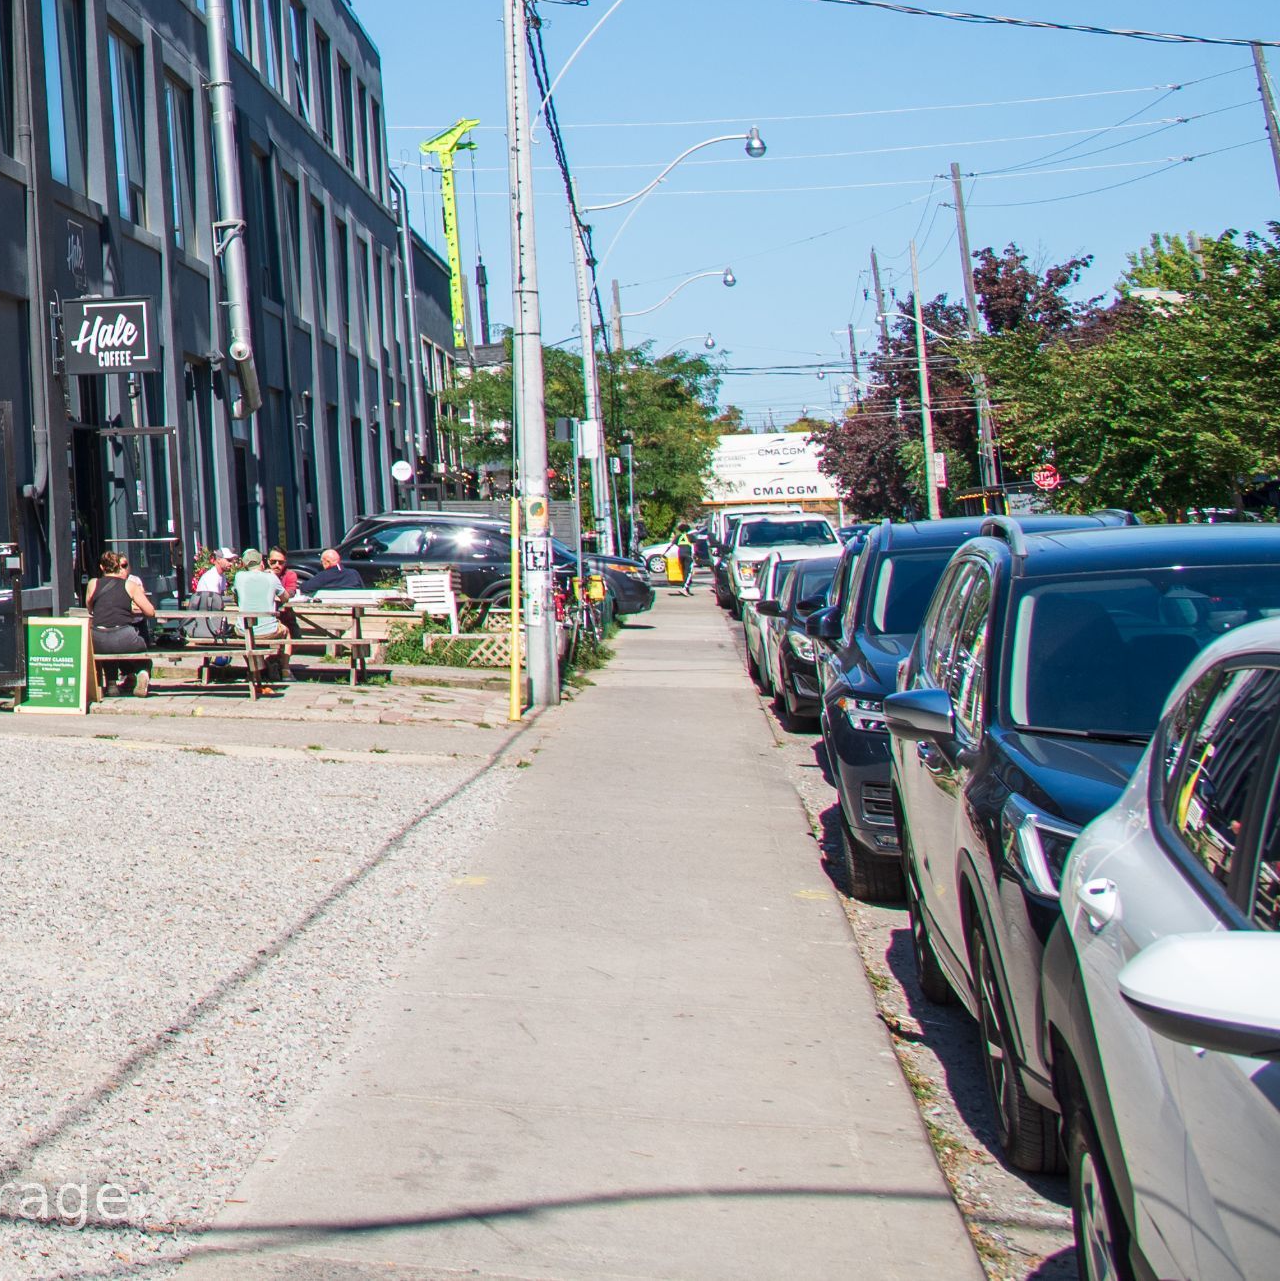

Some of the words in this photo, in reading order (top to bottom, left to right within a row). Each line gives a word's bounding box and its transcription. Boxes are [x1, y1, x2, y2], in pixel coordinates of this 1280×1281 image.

[71, 313, 138, 356] Hale
[98, 350, 132, 367] COFFEE
[758, 448, 781, 456] CMA
[782, 447, 806, 455] CGM
[753, 487, 784, 496] CMA
[787, 486, 818, 495] CGM
